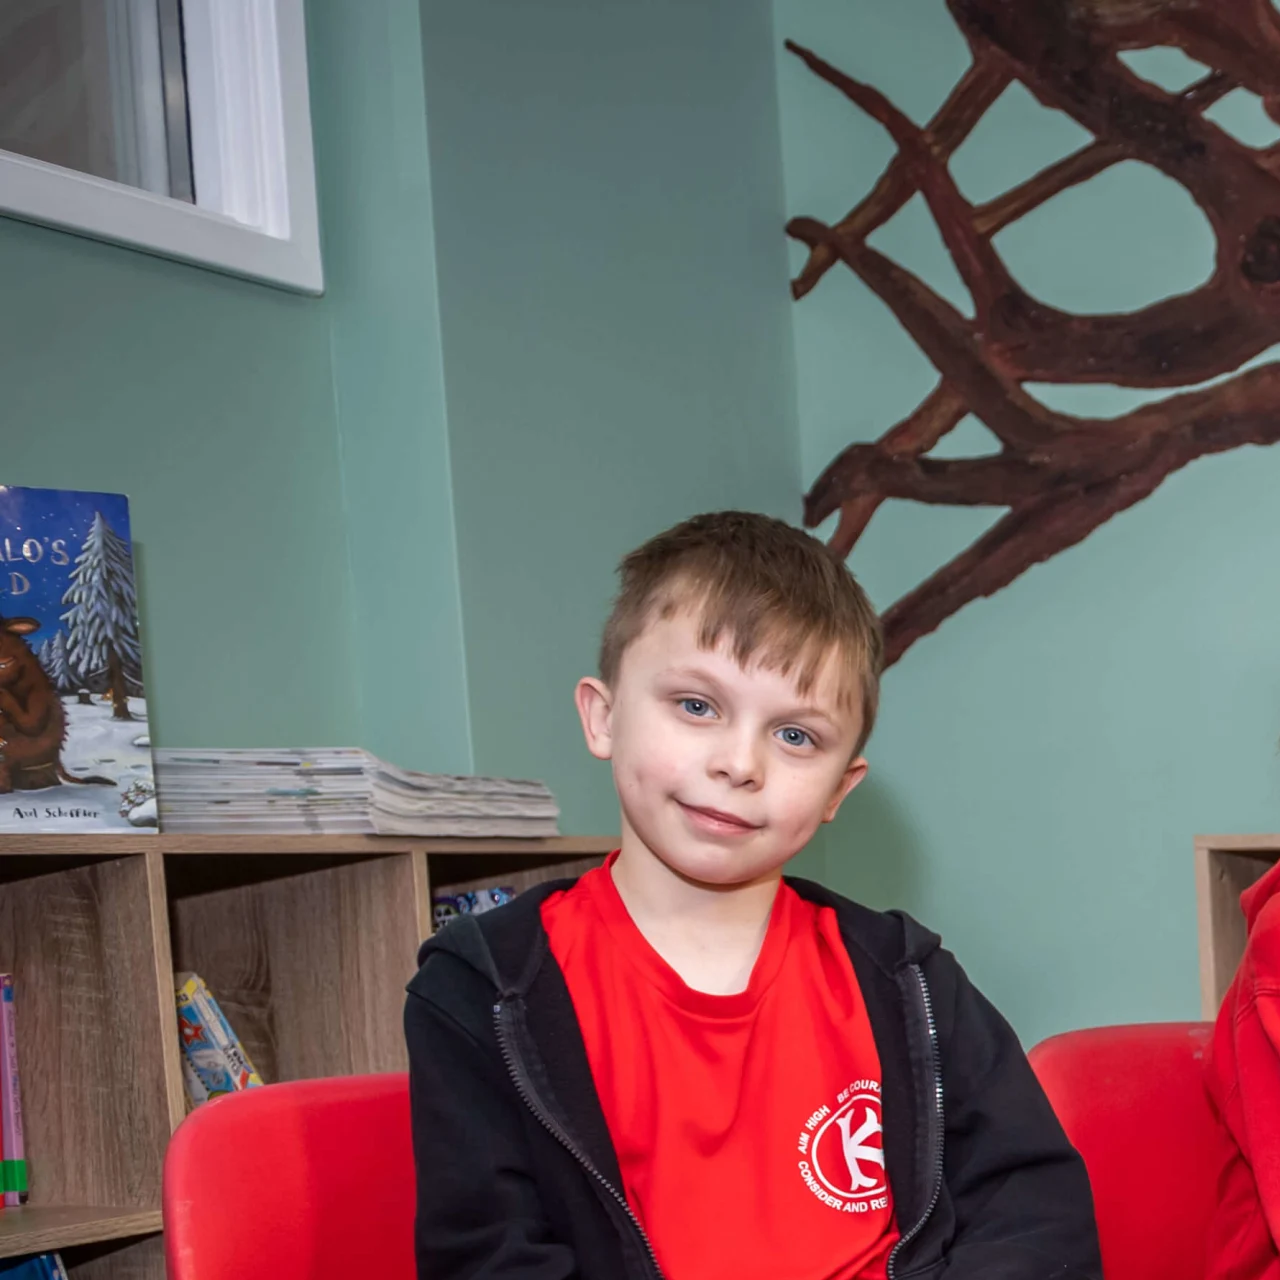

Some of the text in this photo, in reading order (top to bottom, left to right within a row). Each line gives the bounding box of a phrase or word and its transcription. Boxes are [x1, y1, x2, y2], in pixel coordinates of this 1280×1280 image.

[13, 807, 100, 819] Axel Scheffler
[837, 1079, 882, 1104] BE COUR
[797, 1105, 831, 1155] AIM HIGH
[798, 1161, 888, 1213] CONSIDER AND RE
